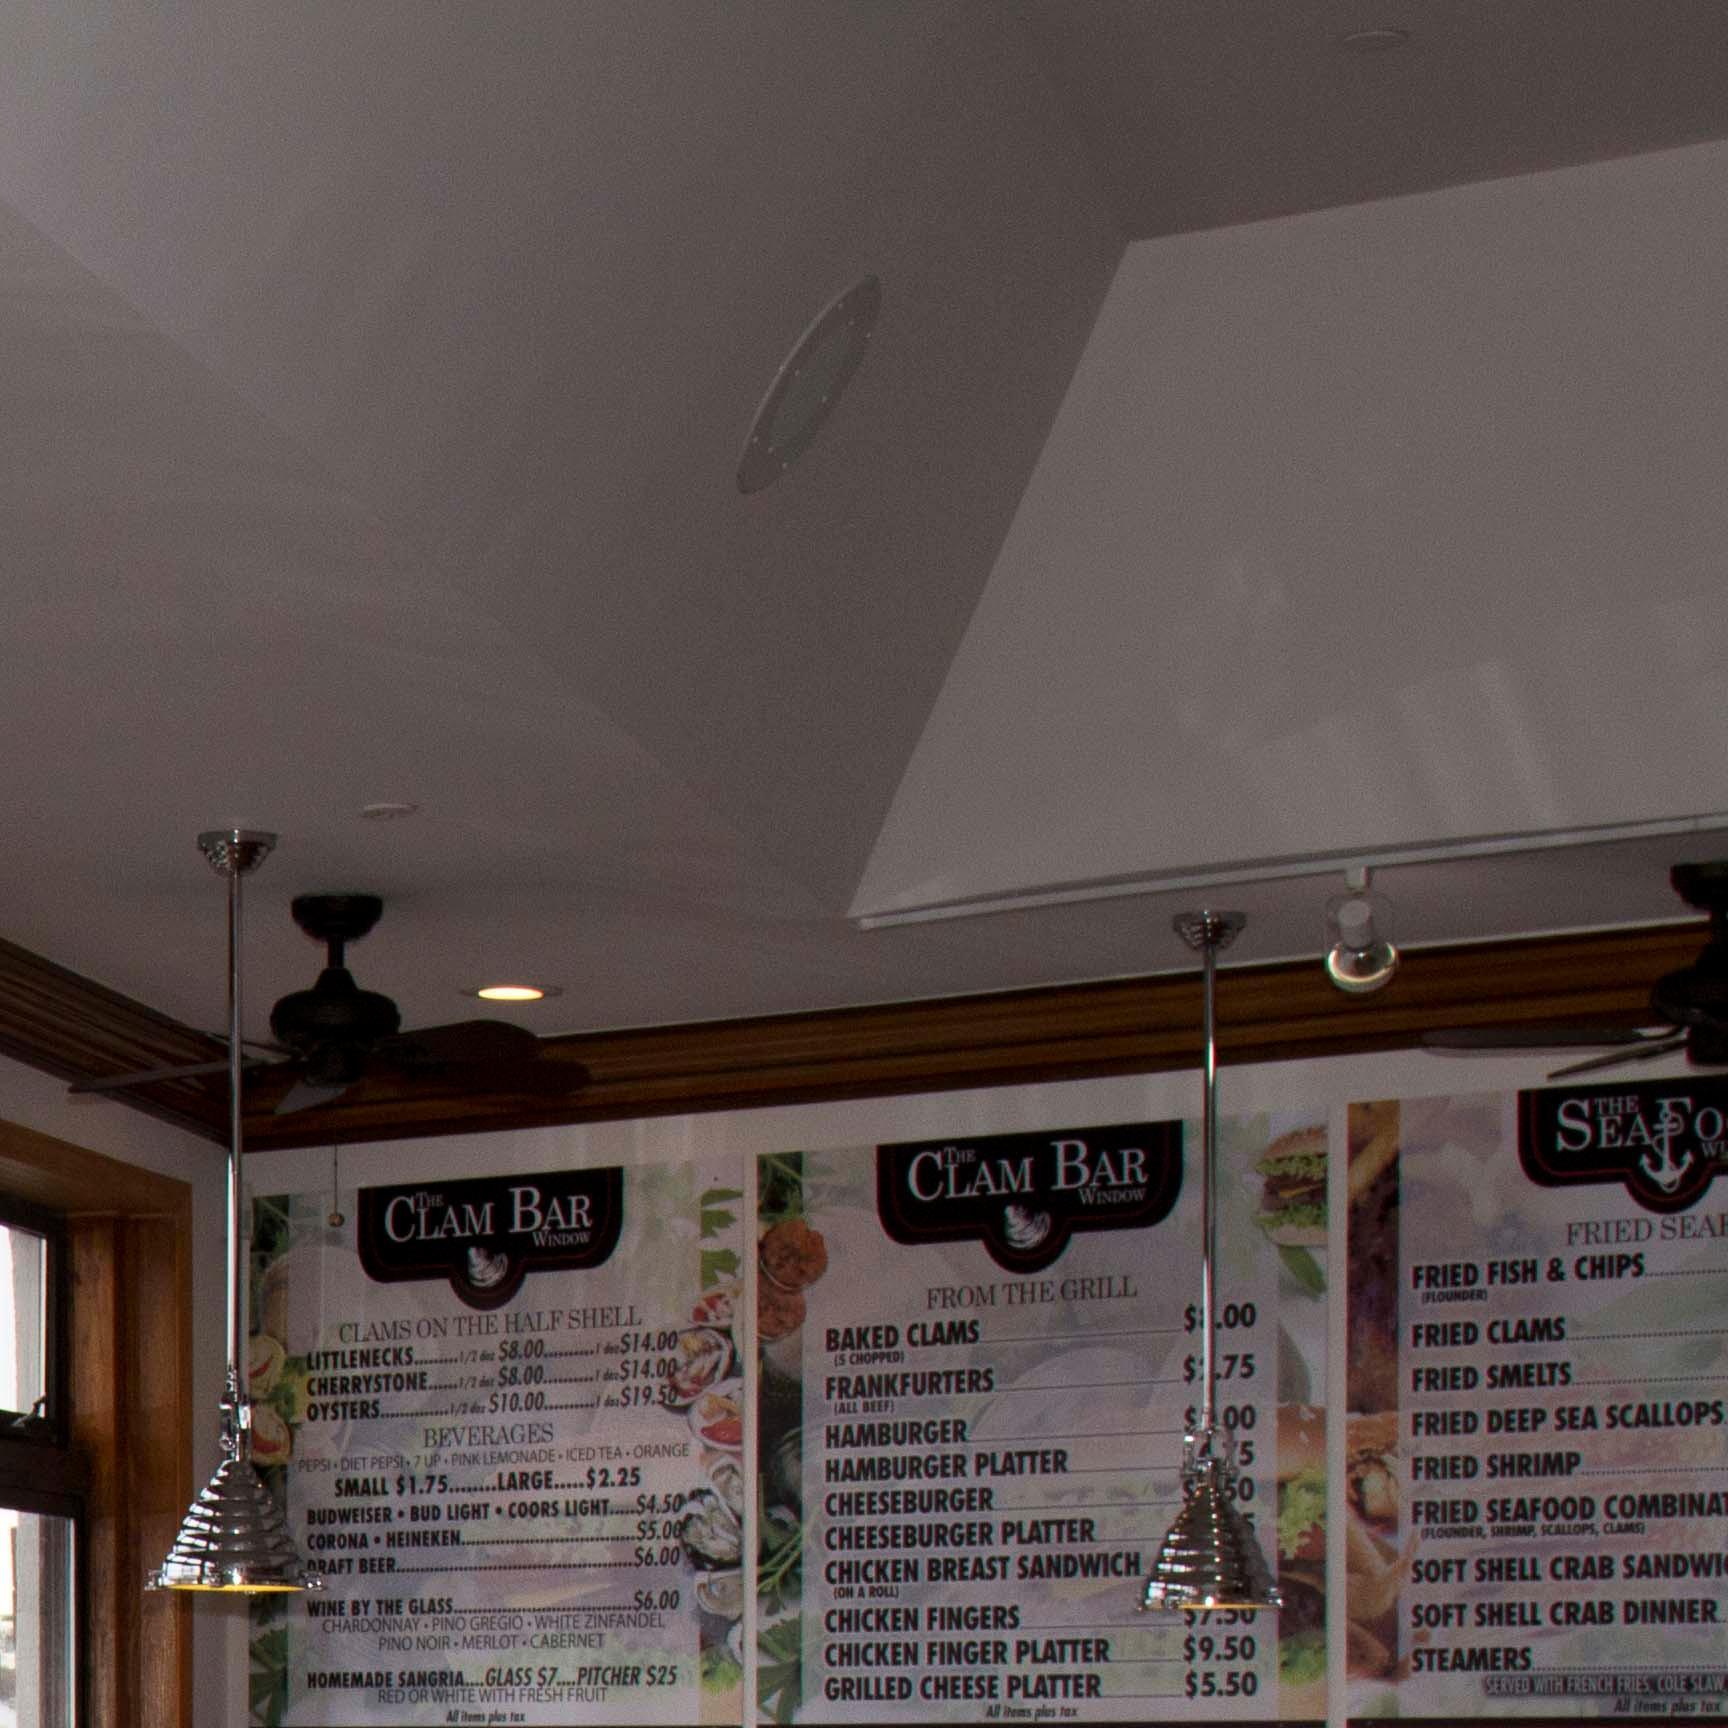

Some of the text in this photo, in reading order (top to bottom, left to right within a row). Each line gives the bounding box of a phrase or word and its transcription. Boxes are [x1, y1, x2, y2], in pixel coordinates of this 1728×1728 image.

[1594, 1095, 1639, 1119] THE
[1557, 1096, 1728, 1151] SEA FO
[907, 1138, 1149, 1201] CLAM BAR
[943, 1147, 977, 1165] THE
[1078, 1186, 1147, 1207] WINDOW
[384, 1185, 593, 1243] CLAM BAR
[532, 1230, 592, 1249] WINDOW
[1567, 1218, 1653, 1246] FRIED
[1412, 1252, 1646, 1290] FRIED FISH & CHIPS
[927, 1276, 1138, 1310] FROM THE GRILL
[339, 1305, 642, 1344] CLAMS ON THE HALF SHELL
[825, 1319, 981, 1353] BAKED CLAMS
[1412, 1315, 1567, 1348] FRIED CLAMS
[306, 1330, 678, 1371] LITTLENECKS $8.00 $14.00
[306, 1357, 678, 1398] CHERRYSTONE $8.00 $14.00
[825, 1367, 995, 1400] FRANKFURTERS
[1412, 1360, 1572, 1392] FRIED SMELTS
[306, 1384, 679, 1422] OYSTERS $10.00 $19.50
[1412, 1399, 1724, 1437] FRIED DEEP SEA SCALLOPS
[424, 1421, 555, 1450] BEVERAGES
[825, 1419, 968, 1449] HAMBURGER
[298, 1458, 331, 1474] PEPSI
[340, 1457, 367, 1472] DIET
[371, 1455, 404, 1471] PEPSI
[451, 1451, 478, 1468] PINK
[482, 1447, 556, 1466] LEMONADE
[566, 1445, 596, 1462] ICED
[598, 1444, 623, 1461] TEA
[633, 1442, 690, 1460] ORANGE
[825, 1448, 1069, 1483] HAMBURGER PLATTER
[1412, 1450, 1582, 1482] FRIED SHRIMP
[334, 1465, 642, 1498] SMALL $1.75 LARGE $2.25
[306, 1491, 683, 1527] BUDWEISER BUD LIGHT COORS LIGHT $4.50
[825, 1487, 994, 1517] CHEESEBURGER
[1412, 1498, 1480, 1526] FRIED
[1486, 1495, 1596, 1524] SEAFOOD
[306, 1519, 683, 1551] CORONA HEINEKEN $5.00
[825, 1517, 1097, 1552] CHEESEBURGER PLATTER
[359, 1555, 397, 1575] BEER
[634, 1545, 681, 1569] $6.00
[825, 1551, 1141, 1586] CHICKEN BREAST SANDWICH
[1412, 1557, 1467, 1584] SOFT
[1474, 1556, 1542, 1583] SHELL
[1548, 1554, 1616, 1582] CRAB
[306, 1588, 681, 1618] WINE BY THE GLASS $6.00
[825, 1606, 919, 1634] CHICKEN
[926, 1604, 1020, 1632] FINGERS
[1412, 1597, 1718, 1629] SOFT SHELL CRAB DINNER
[323, 1609, 666, 1635] CHARDONNAY PINO GREGIO WHITE ZINFANDEL
[378, 1631, 606, 1652] PINO NOIR MERLOT CABERNET
[825, 1633, 1257, 1668] CHICKEN FINGER PLATTER $9.50
[1412, 1645, 1533, 1673] STEAMERS
[306, 1664, 678, 1690] HOMEMADE SANGRIA GLASS $7 PITCHER $25
[824, 1668, 1258, 1702] GRILLED CHEESE PLATTER $5.50
[378, 1686, 609, 1704] RED OR WHITE WITH FRESH FRUIT
